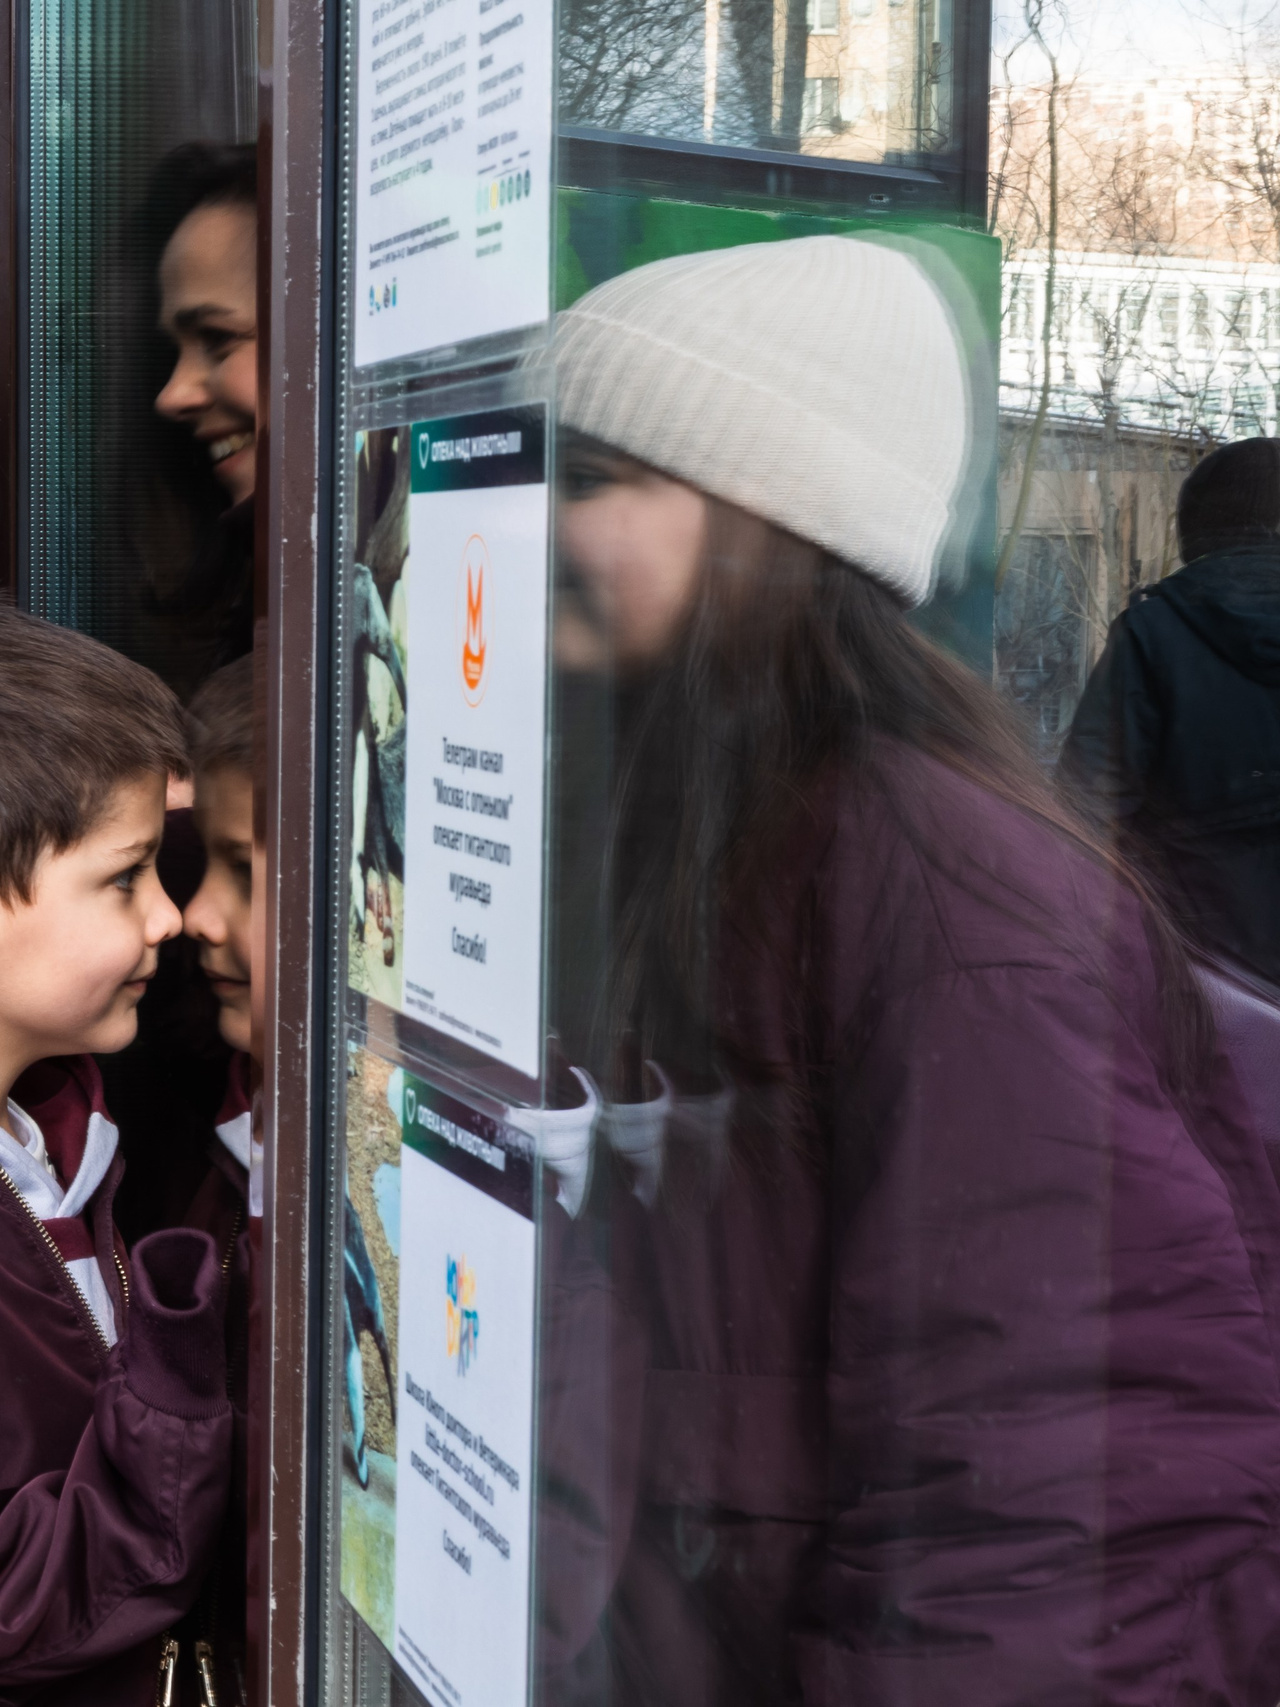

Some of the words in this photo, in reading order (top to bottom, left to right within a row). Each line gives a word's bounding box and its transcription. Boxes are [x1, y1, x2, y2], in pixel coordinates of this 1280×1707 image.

[442, 737, 479, 774] Телеграм
[479, 750, 504, 775] канал
[433, 825, 464, 852] опекает
[449, 872, 492, 908] муравьеда
[452, 926, 487, 965] Спасибо!
